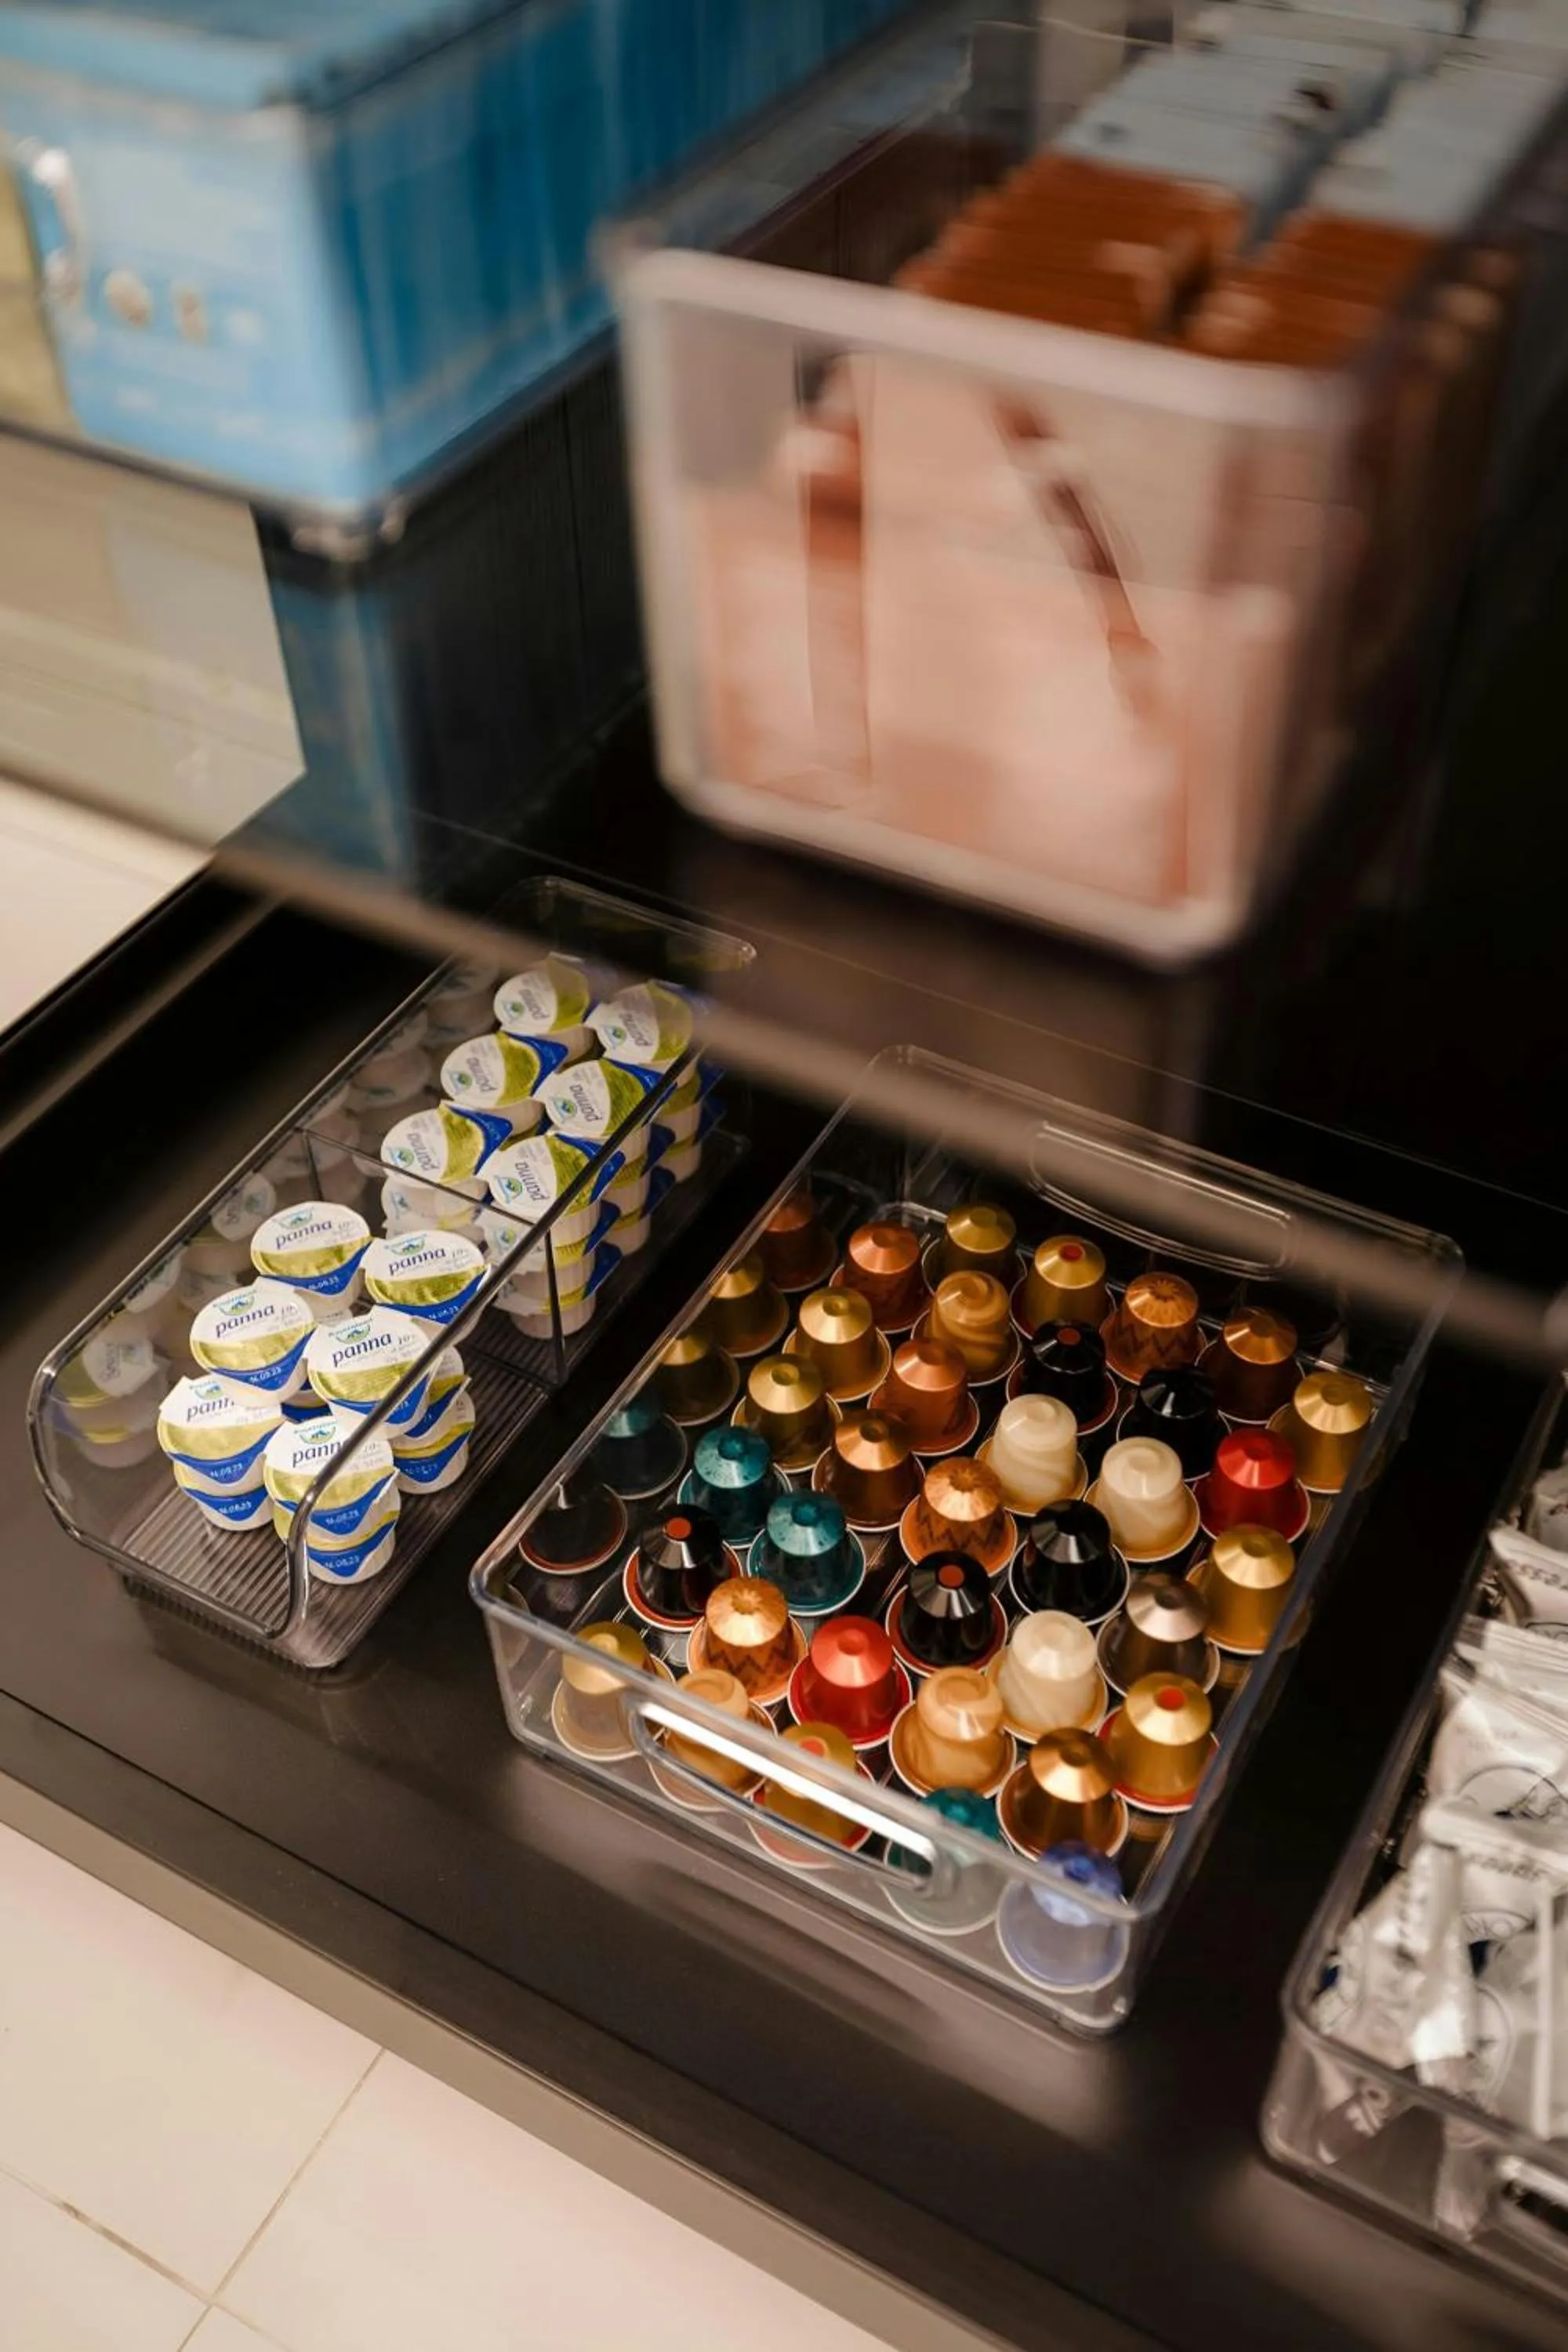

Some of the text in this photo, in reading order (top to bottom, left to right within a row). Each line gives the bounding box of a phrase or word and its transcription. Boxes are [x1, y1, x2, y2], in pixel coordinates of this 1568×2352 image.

[466, 1057, 498, 1092] panna
[569, 1083, 603, 1122] panna
[408, 1133, 440, 1171] panna
[515, 1161, 550, 1201] panna
[275, 1220, 332, 1250] panna
[389, 1248, 446, 1276] panna
[216, 1305, 274, 1338] panna
[332, 1333, 392, 1367] panna
[187, 1397, 234, 1423] pann
[292, 1441, 343, 1468] pann
